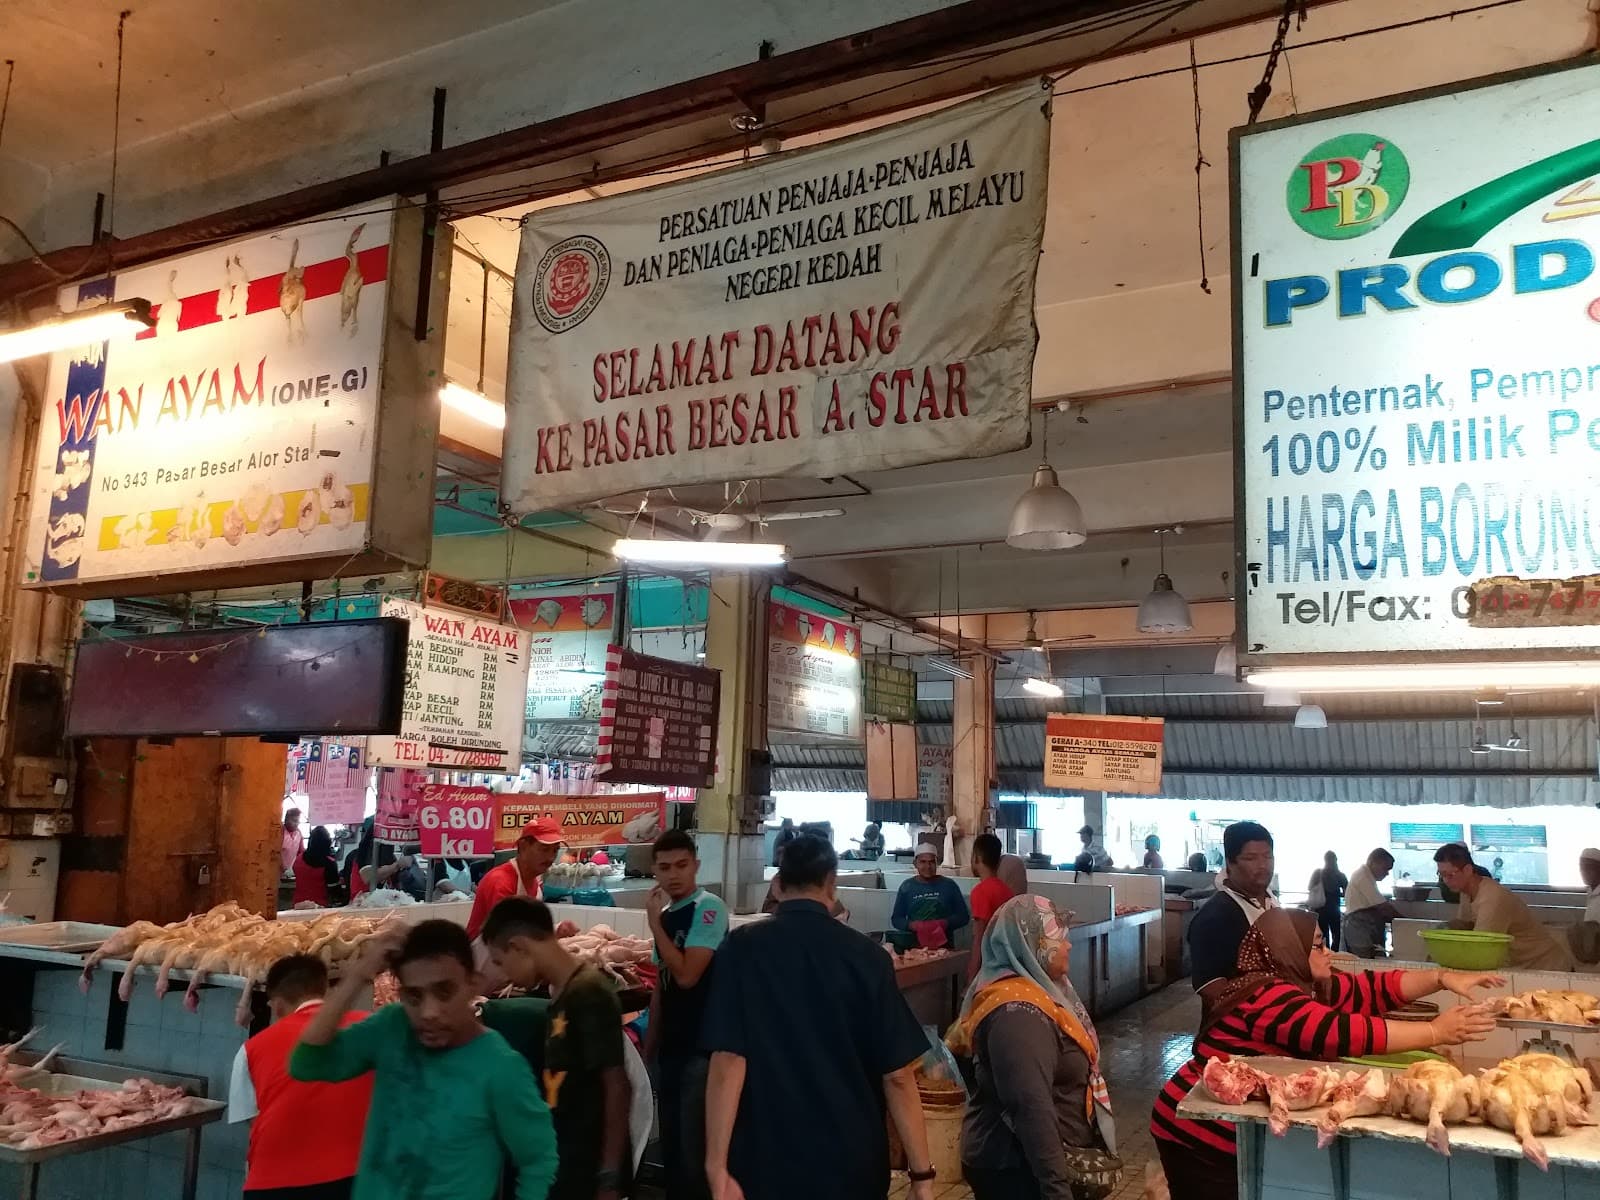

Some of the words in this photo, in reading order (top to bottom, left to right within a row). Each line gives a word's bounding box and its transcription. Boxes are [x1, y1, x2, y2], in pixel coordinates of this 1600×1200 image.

[659, 190, 772, 243] PERSATUAN
[623, 253, 662, 287] DAN
[853, 194, 920, 236] KECIL
[926, 170, 1025, 221] MELAYU
[725, 260, 801, 303] NEGERI
[806, 243, 882, 286] KEDAH
[592, 330, 740, 403] SELAMAT
[750, 301, 900, 376] DATANG
[56, 381, 144, 446] WAN
[156, 355, 267, 424] AYAM
[271, 366, 368, 408] (ONE-G)
[535, 422, 574, 475] KE
[583, 411, 678, 468] PASAR
[687, 384, 800, 451] BESAR
[867, 362, 969, 428] STAR
[1262, 424, 1388, 477] 100%
[1407, 413, 1527, 468] Milik
[102, 476, 119, 492] No
[124, 471, 148, 489] 343
[156, 464, 197, 485] Pasar
[200, 458, 243, 478] Besar
[247, 450, 279, 470] Alor
[1266, 488, 1409, 585] HARGA
[1276, 588, 1432, 624] Tel/Fax:
[424, 614, 465, 639] WAN
[471, 625, 519, 650] AYAM
[428, 653, 458, 666] HIDUP
[483, 662, 497, 672] RM
[429, 643, 464, 657] BERSIH
[483, 652, 498, 663] RM
[427, 662, 475, 679] KAMPUNG
[482, 672, 496, 682] RM
[480, 691, 494, 701] RM
[481, 681, 495, 692] RM
[426, 703, 454, 716] KECIL
[478, 711, 493, 720] RM
[427, 693, 460, 706] BESAR
[479, 701, 494, 711] RM
[420, 714, 464, 727] JANTUNG
[477, 720, 492, 730] RM
[394, 742, 424, 761] TEL:
[431, 735, 457, 744] BOLEH
[461, 737, 502, 749] DIRUNDING
[423, 785, 445, 802] Ed
[446, 787, 489, 806] Ayam
[503, 804, 541, 812] KEPADA
[543, 803, 582, 811] PEMBELI
[584, 802, 608, 810] YANG
[610, 801, 658, 809] DIHORMATI
[502, 813, 553, 828] BE
[562, 810, 624, 826] AYAM
[441, 833, 475, 857] kg
